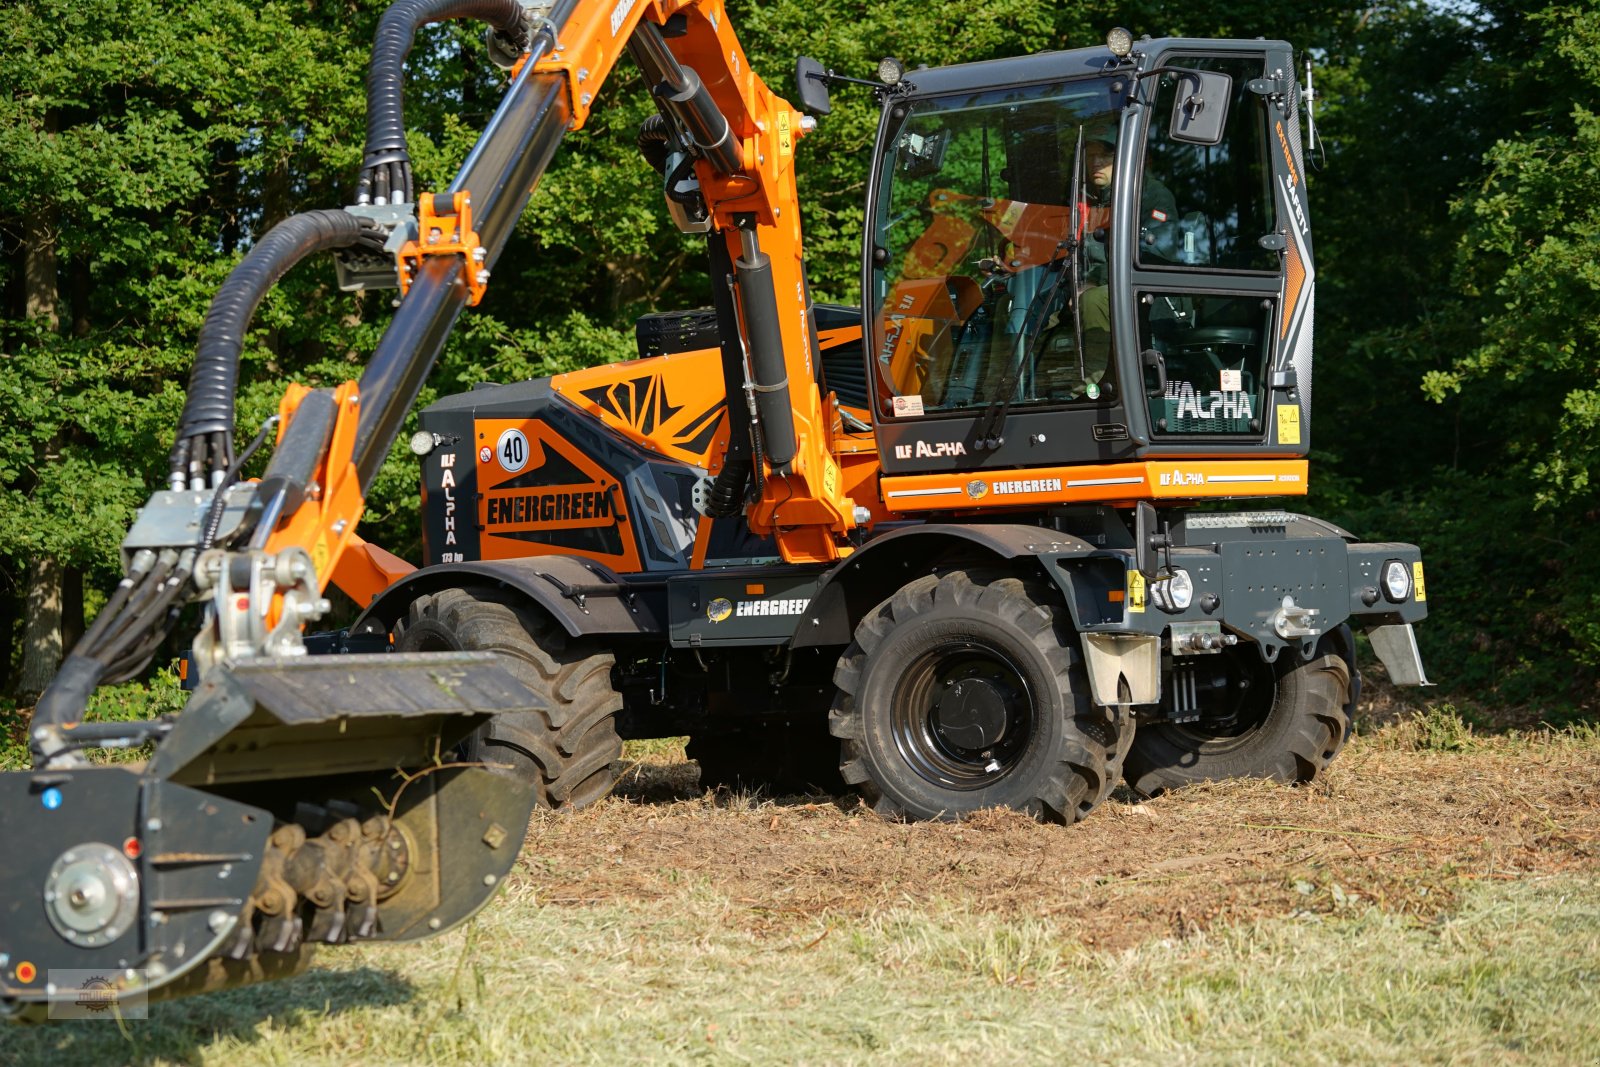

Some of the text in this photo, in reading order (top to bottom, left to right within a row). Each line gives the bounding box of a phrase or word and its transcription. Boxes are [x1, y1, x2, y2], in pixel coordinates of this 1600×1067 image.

[1276, 120, 1299, 187] EXTREME
[1286, 174, 1308, 236] SAFETY
[1177, 381, 1253, 419] ALPHA
[441, 454, 456, 467] ILF
[503, 437, 523, 464] 40
[895, 440, 967, 459] ILF ALPHA
[993, 479, 1062, 495] ENERGREEN
[1160, 470, 1204, 486] ILF ALPHA
[487, 491, 611, 525] ENERGREEN
